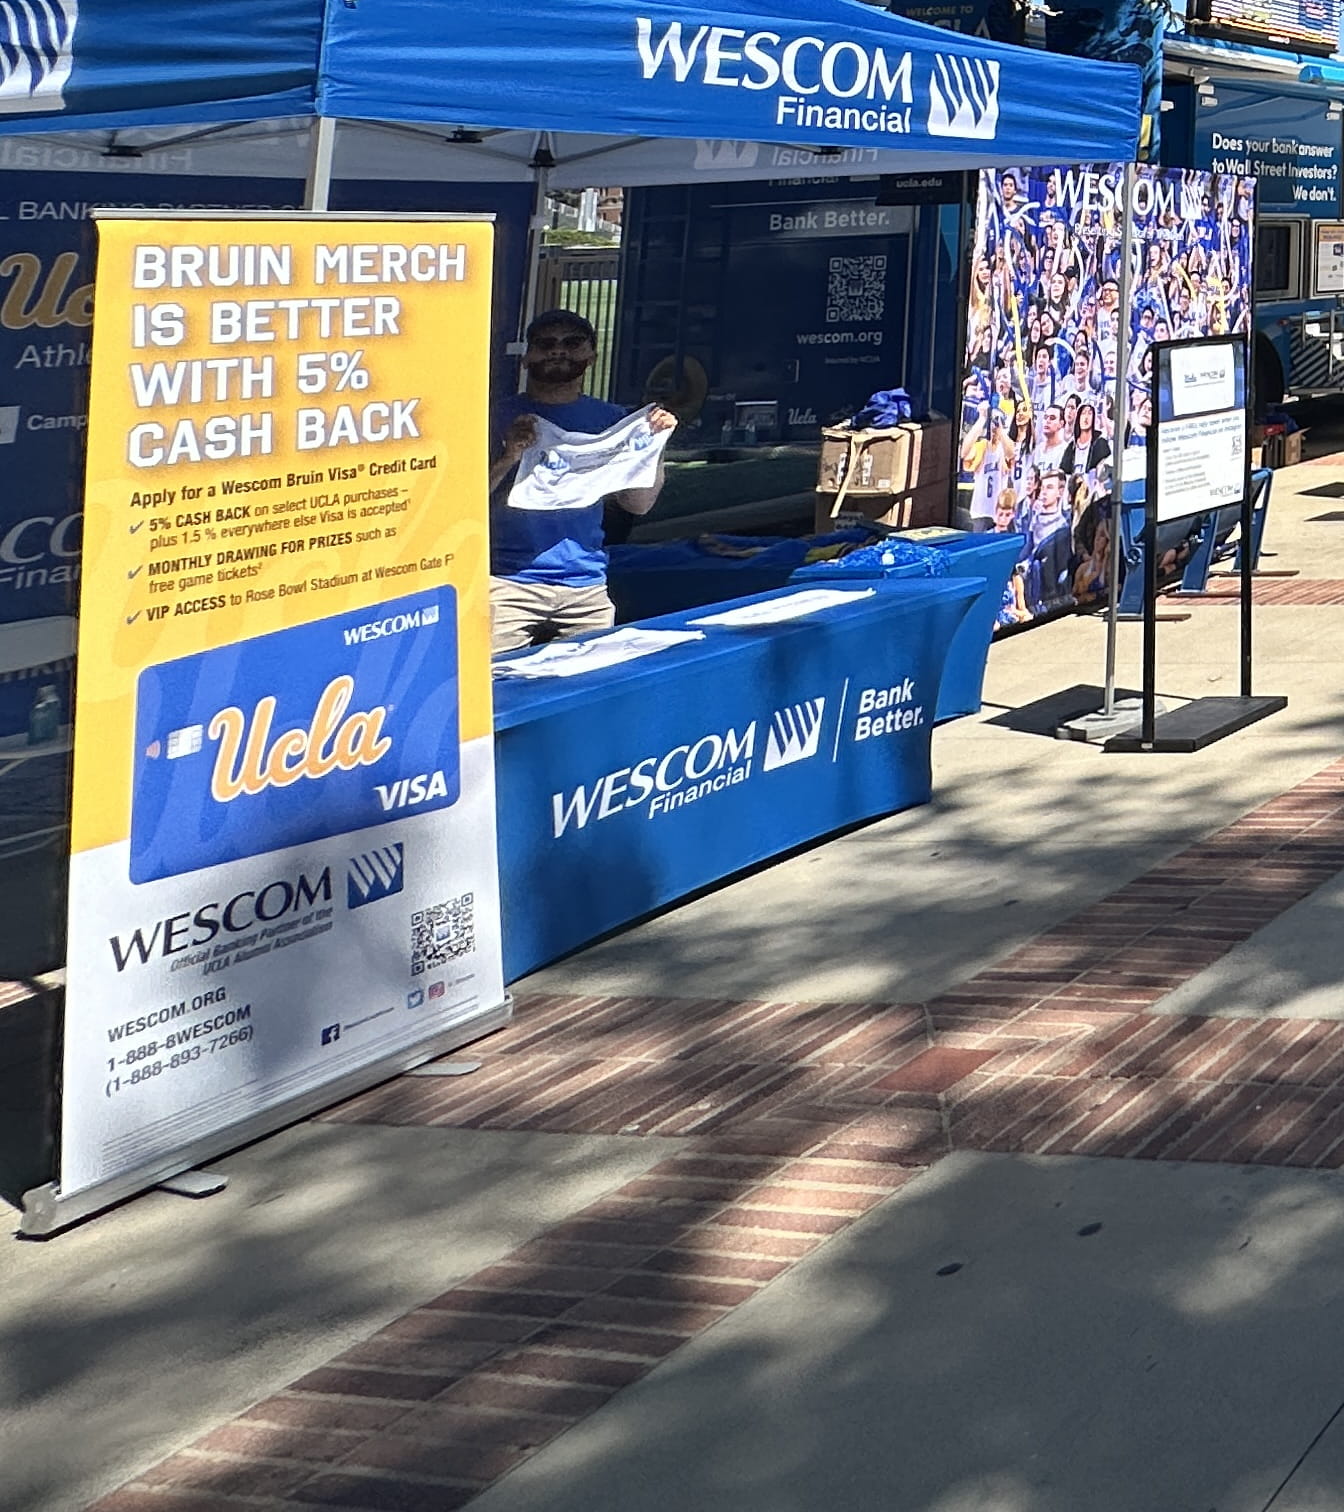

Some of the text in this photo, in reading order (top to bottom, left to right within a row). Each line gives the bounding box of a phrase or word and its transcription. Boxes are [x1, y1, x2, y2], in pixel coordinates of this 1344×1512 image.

[906, 4, 974, 16] WELCOME TO
[636, 17, 914, 105] WESCOM
[776, 95, 913, 134] Financial
[1212, 133, 1334, 158] Does your bank answer
[896, 177, 942, 188] ucla.edu
[1212, 158, 1338, 181] to Wall Street Investors?
[1292, 185, 1337, 202] We don't.
[769, 209, 890, 232] Bank Better.
[133, 244, 466, 289] BRUIN MERCH
[132, 296, 400, 348] IS BETTER
[796, 330, 883, 346] wescom.org
[129, 350, 369, 408] WITH 5%
[127, 398, 422, 470] CASH BACK
[130, 489, 176, 509] Apply
[181, 485, 203, 501] for
[207, 485, 216, 498] a
[221, 476, 282, 496] Wescom
[286, 471, 324, 488] Bruin
[369, 460, 407, 477] Credit
[410, 455, 437, 471] Card
[149, 517, 172, 533] 5%
[175, 511, 212, 528] CASH
[215, 504, 251, 522] BACK
[254, 504, 269, 517] on
[272, 497, 307, 515] select
[310, 493, 341, 510] UCLA
[343, 487, 399, 507] purchases
[149, 534, 177, 552] plus
[181, 529, 201, 545] 1.5
[204, 527, 217, 541] %
[220, 518, 291, 541] everywhere
[293, 511, 317, 528] else
[319, 509, 344, 524] Visa
[347, 506, 357, 520] is
[148, 527, 397, 576] MONTHLY DRAWING FOR PRIZES such as
[146, 605, 170, 622] VIP
[173, 594, 226, 618] ACCESS
[229, 593, 242, 606] to
[245, 586, 276, 604] Rose
[278, 579, 308, 598] Bowl
[310, 571, 359, 592] Stadium
[361, 569, 373, 583] at
[374, 561, 419, 580] Wescom
[419, 556, 443, 572] Gate
[149, 578, 175, 595] free
[178, 572, 214, 593] game
[343, 608, 422, 647] WESCOM
[858, 678, 915, 715] Bank
[207, 674, 394, 804] Ucla
[853, 705, 925, 742] Better.
[373, 770, 448, 812] VISA
[552, 720, 757, 839] WESCOM
[647, 759, 752, 819] Financial
[108, 865, 334, 974] WESCOM
[169, 906, 333, 973] Official Banking Partner of the
[202, 957, 232, 977] UCLA
[233, 946, 271, 968] Alumni
[106, 986, 228, 1044] WESCOM.ORG
[106, 1003, 252, 1073] 1-888-8WESCOM
[105, 1025, 255, 1098] (1-888-893-7266)
